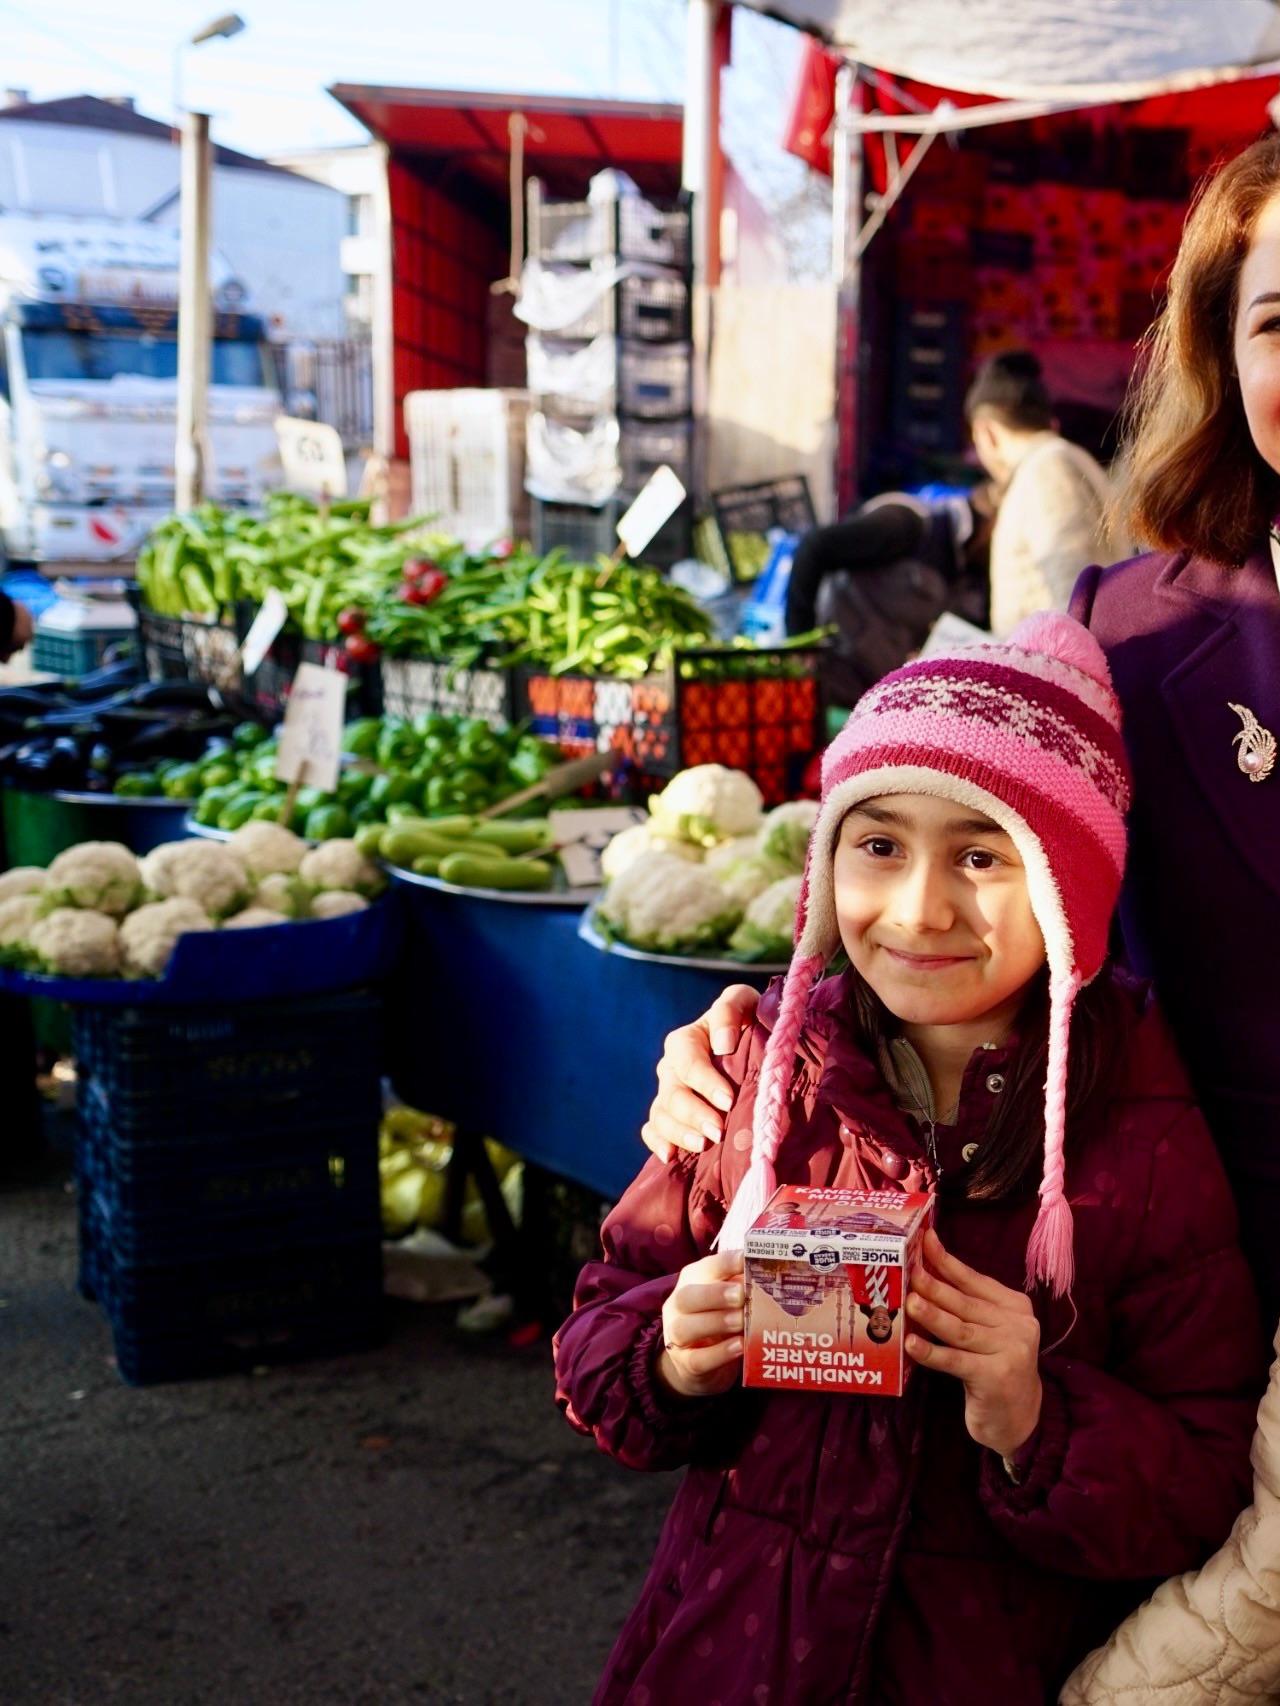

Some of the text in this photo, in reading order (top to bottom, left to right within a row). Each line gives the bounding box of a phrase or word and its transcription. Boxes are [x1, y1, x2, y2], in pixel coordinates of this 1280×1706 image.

[808, 1194, 908, 1206] MUBAREK
[834, 1201, 904, 1211] OLSUN
[762, 1329, 834, 1348] OLSUN
[762, 1347, 865, 1367] MUBAREK
[762, 1364, 882, 1385] KANDİLİMİZ
